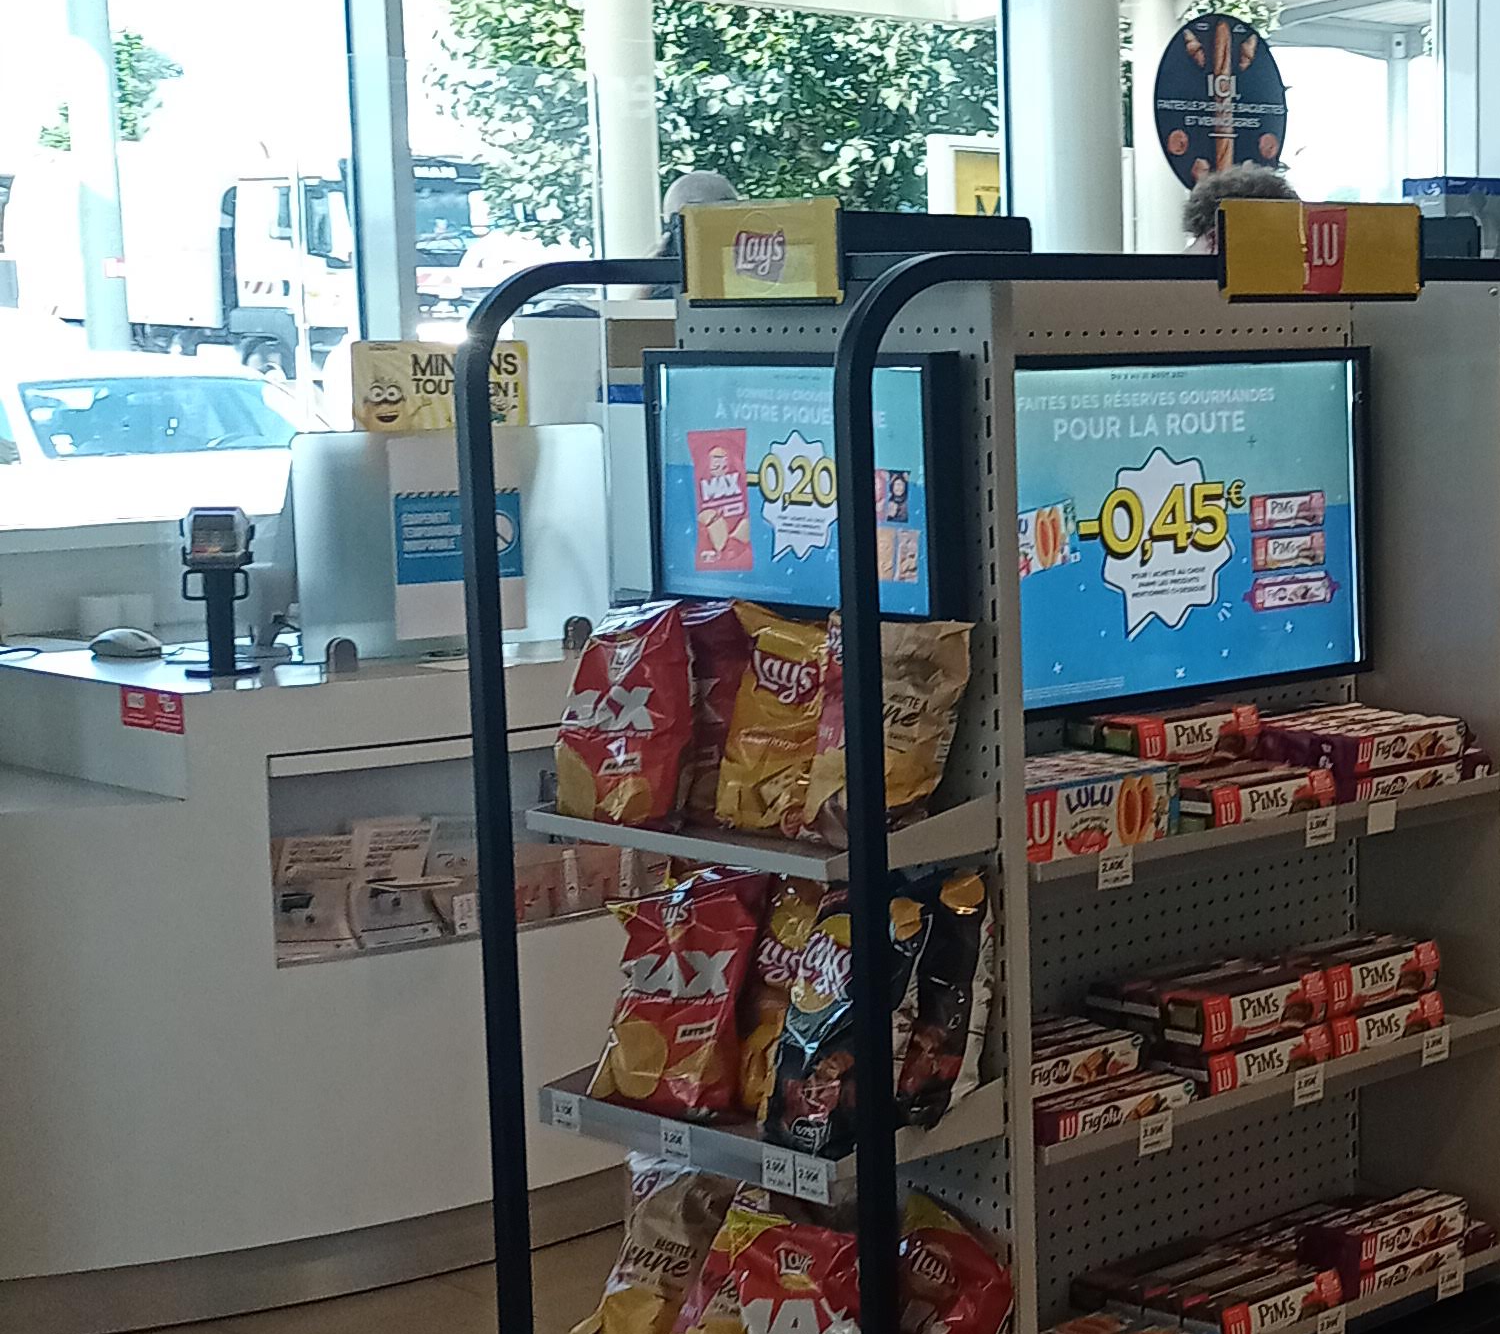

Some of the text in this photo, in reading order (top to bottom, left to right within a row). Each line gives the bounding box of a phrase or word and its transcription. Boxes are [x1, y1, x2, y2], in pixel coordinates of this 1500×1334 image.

[735, 229, 785, 276] Lay's
[1311, 223, 1339, 266] LU
[411, 353, 519, 377] MINNS
[1016, 387, 1275, 412] FAITES DES RÉSERVES GOURMANDES
[1053, 410, 1246, 441] POUR LA ROUTE
[752, 648, 818, 704] Lay's
[1145, 735, 1160, 758] LU
[1173, 723, 1213, 747] PiM's
[1358, 740, 1373, 763] LU
[1065, 785, 1113, 815] LULU
[1221, 802, 1236, 825] LU
[1248, 787, 1288, 814] PiM's
[1358, 961, 1396, 989] PiM's
[1333, 978, 1348, 1002] LU
[1239, 992, 1280, 1021] PiM's
[1211, 1010, 1227, 1035] LU
[1365, 1013, 1401, 1041] PiM's
[1244, 1047, 1284, 1078] PiM's
[1258, 1295, 1296, 1328] PiM's
